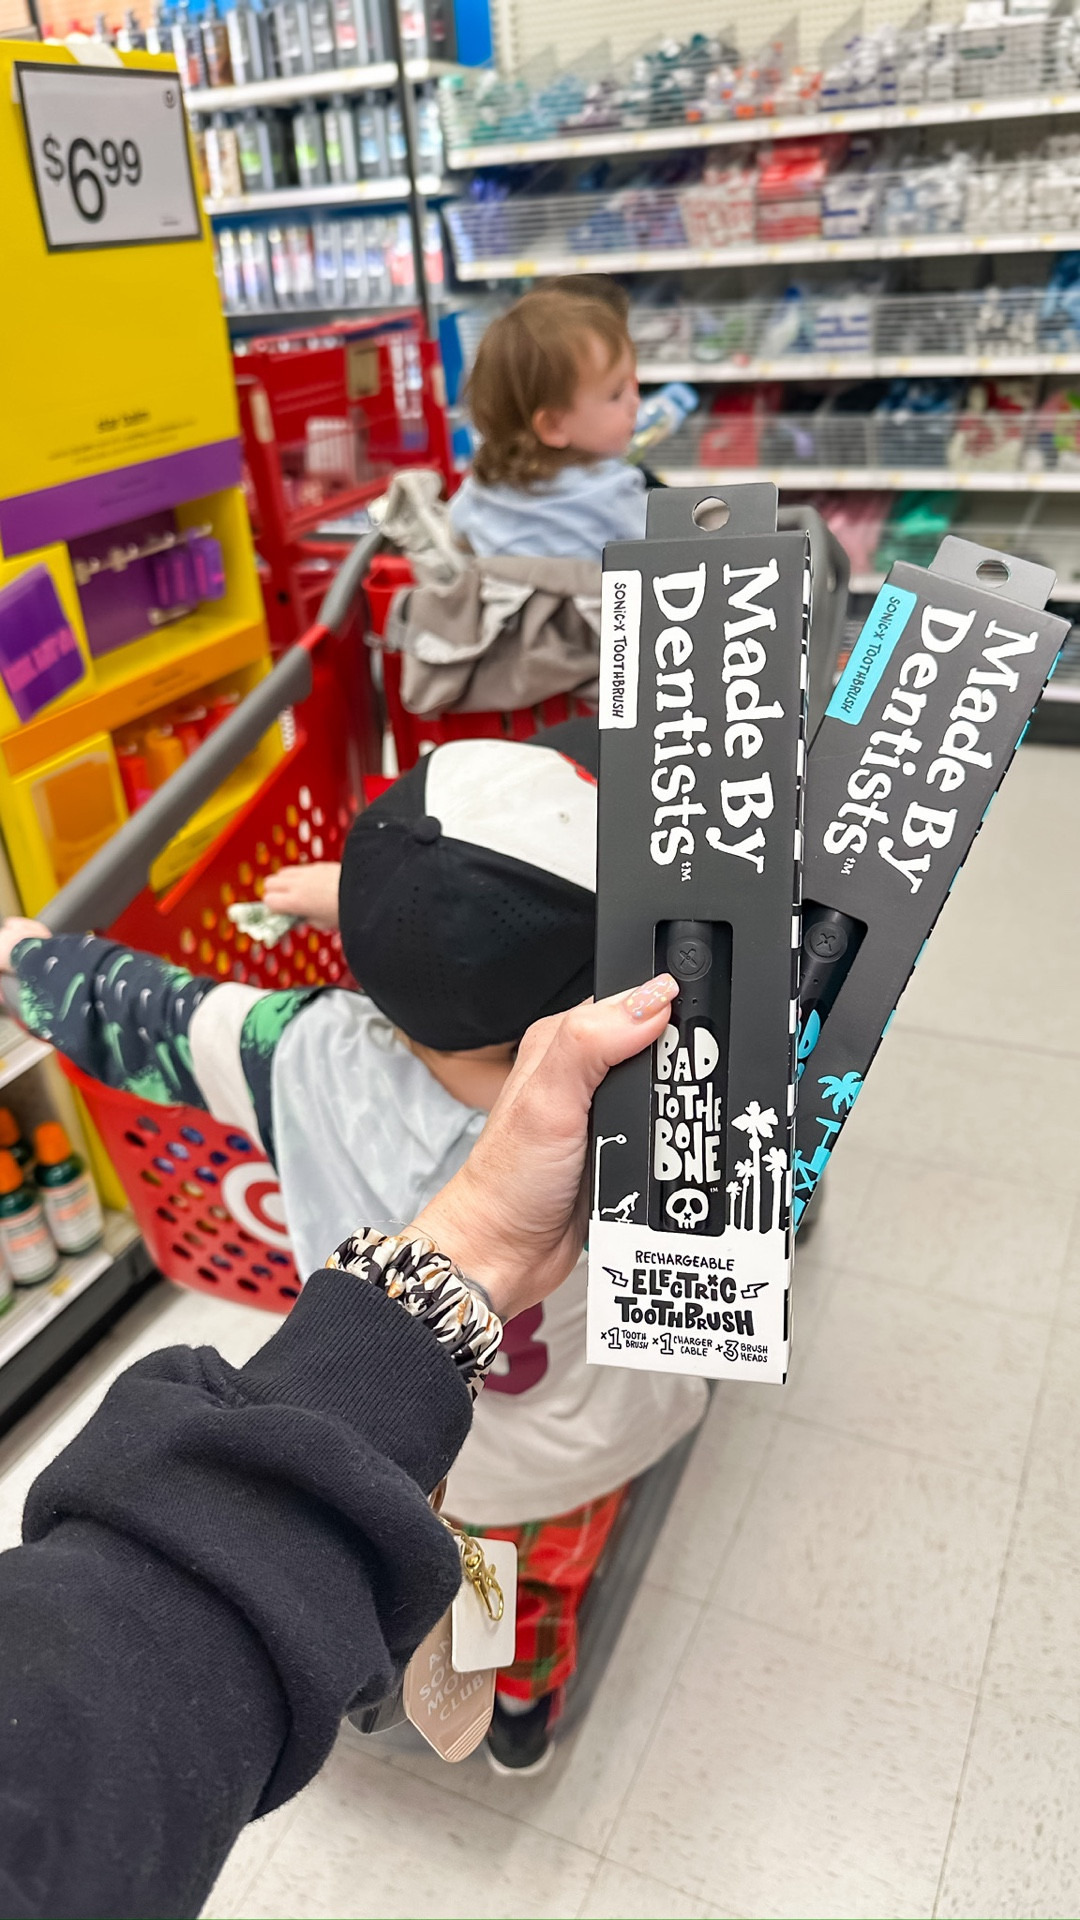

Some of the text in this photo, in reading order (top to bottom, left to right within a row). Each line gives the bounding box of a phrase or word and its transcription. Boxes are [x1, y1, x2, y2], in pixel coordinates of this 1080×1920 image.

[611, 635, 627, 719] TOOTHBRUSH
[841, 641, 882, 714] TOOTHBRUSH
[649, 562, 712, 866] Dentists
[705, 557, 785, 874] Made By
[823, 604, 977, 855] Dentists
[877, 619, 1039, 895] Made By
[656, 1023, 720, 1082] BAD
[654, 1082, 722, 1132] TO THE
[654, 1117, 721, 1184] BONE
[635, 1250, 735, 1271] RECHARGEABLE
[614, 1296, 755, 1336] TOOTHBRUSH
[621, 1329, 647, 1340] TOOTH
[625, 1339, 649, 1350] BRUSH
[673, 1335, 713, 1348] CHARGER
[680, 1345, 708, 1357] CABLE
[740, 1343, 768, 1354] BRUSH
[740, 1352, 768, 1363] HEADS
[440, 1674, 484, 1721] CLUB
